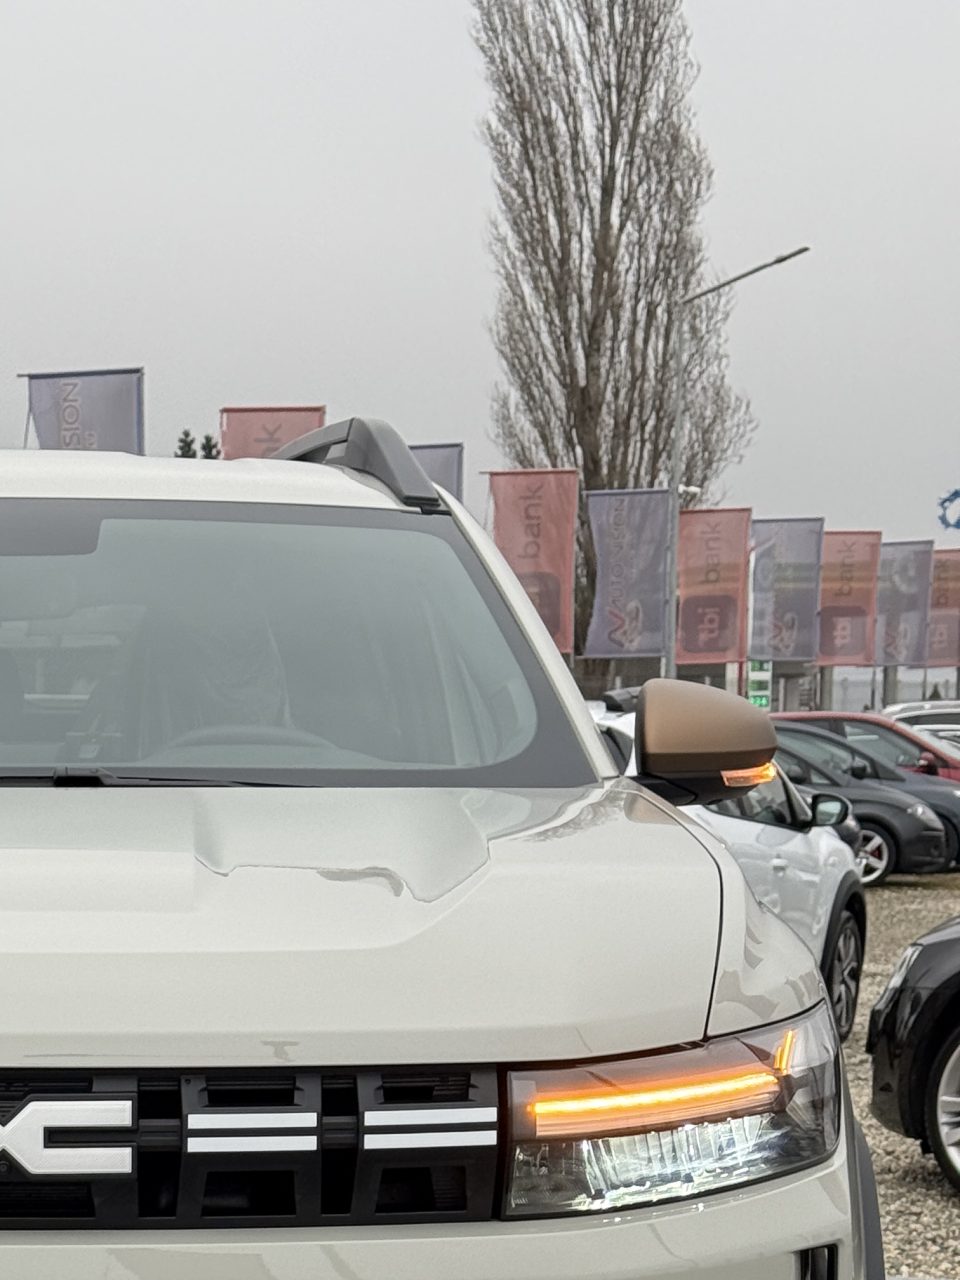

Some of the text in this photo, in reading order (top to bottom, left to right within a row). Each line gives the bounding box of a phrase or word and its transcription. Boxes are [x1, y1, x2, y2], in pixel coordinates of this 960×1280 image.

[518, 484, 543, 560] bank
[697, 521, 721, 647] tbi bank
